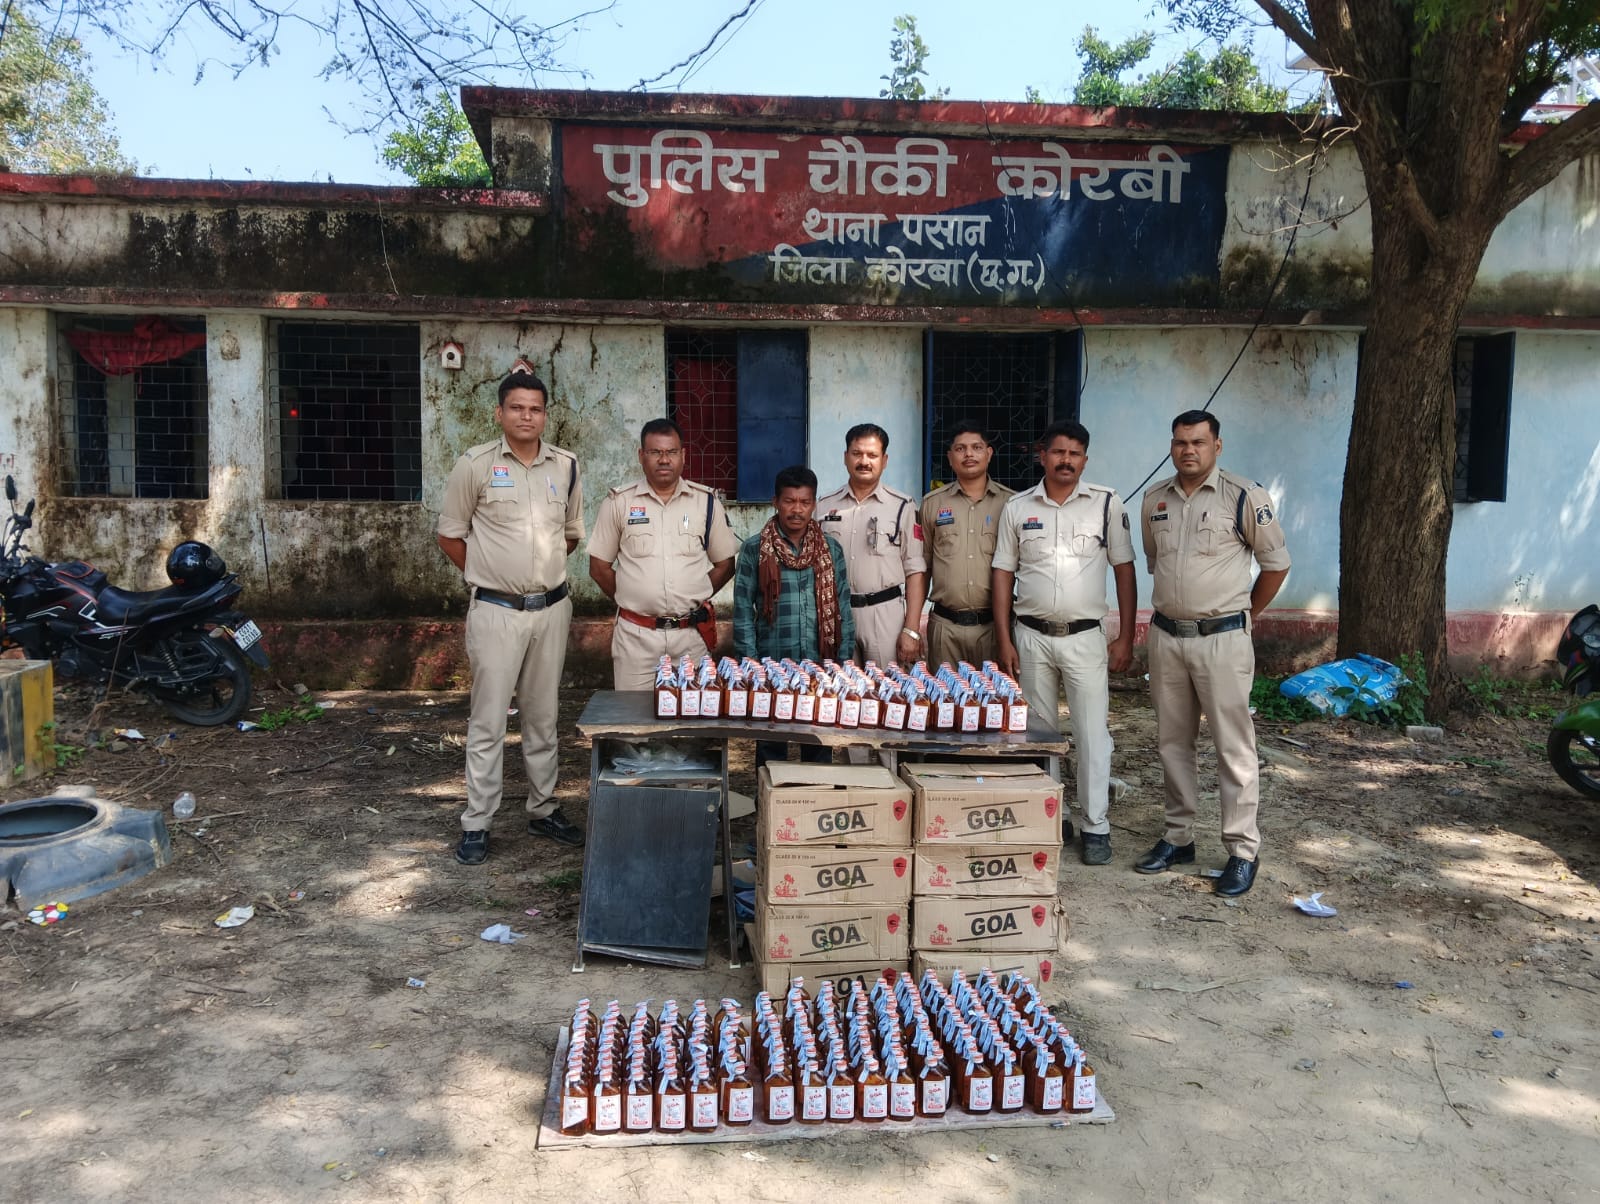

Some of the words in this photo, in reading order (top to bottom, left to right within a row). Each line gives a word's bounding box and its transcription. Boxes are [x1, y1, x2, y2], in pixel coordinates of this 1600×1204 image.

[593, 129, 780, 208] पुलिस
[807, 135, 958, 198] चौकी
[992, 142, 1191, 204] कोरबी
[802, 207, 888, 248] थाना
[896, 214, 993, 250] पसान
[768, 243, 855, 285] जिला
[817, 809, 866, 834] GOA
[967, 806, 1017, 830] GOA
[816, 864, 866, 889] GOA
[970, 857, 1018, 879] GOA
[970, 912, 1018, 937] GOA
[811, 925, 862, 950] GOA
